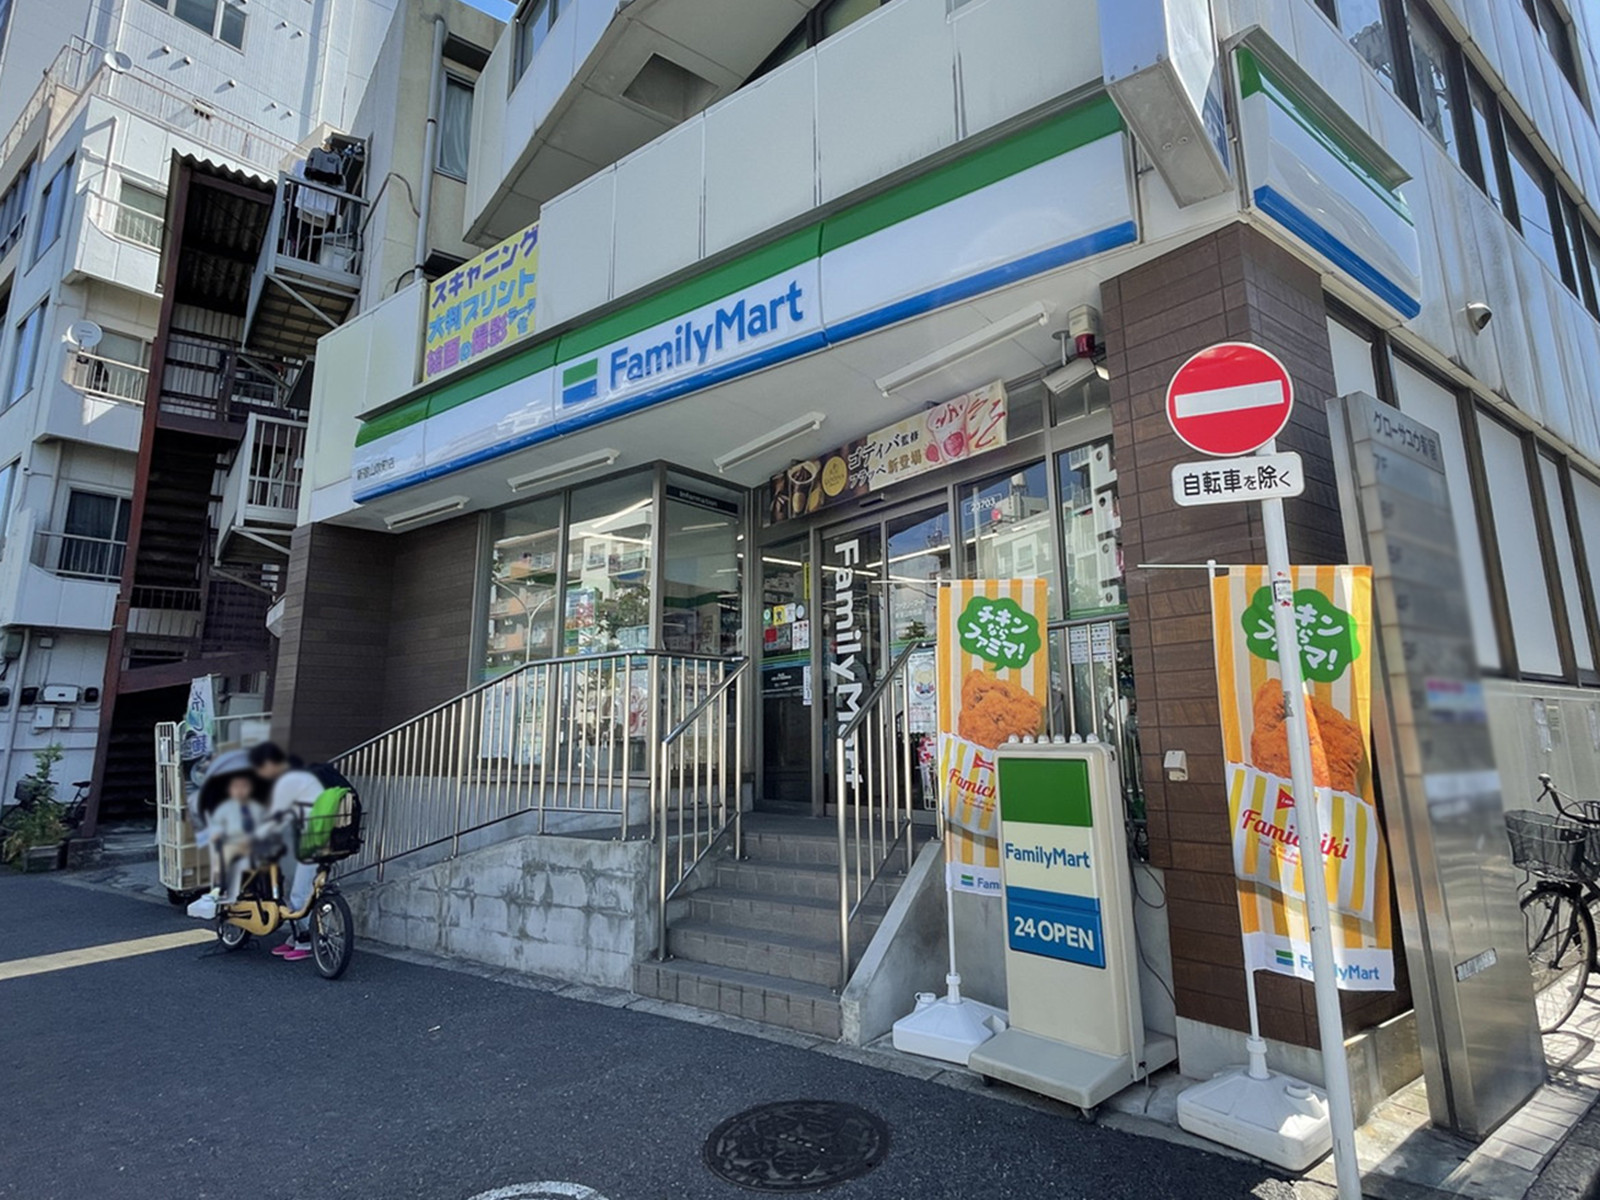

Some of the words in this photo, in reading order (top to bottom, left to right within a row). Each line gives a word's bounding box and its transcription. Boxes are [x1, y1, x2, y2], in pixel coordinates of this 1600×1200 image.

[432, 225, 539, 308] スキャニング
[610, 280, 804, 390] FamilyMart
[1183, 465, 1291, 496] 自転車を除く
[977, 606, 1030, 634] チキン
[987, 623, 1009, 640] なら
[964, 622, 1026, 660] ファミマ!
[1253, 619, 1339, 671] フマ!
[1242, 809, 1350, 860] Famiciki
[1005, 843, 1091, 869] FamilyMart
[977, 877, 1001, 890] Fam
[1299, 955, 1380, 981] FalyMart
